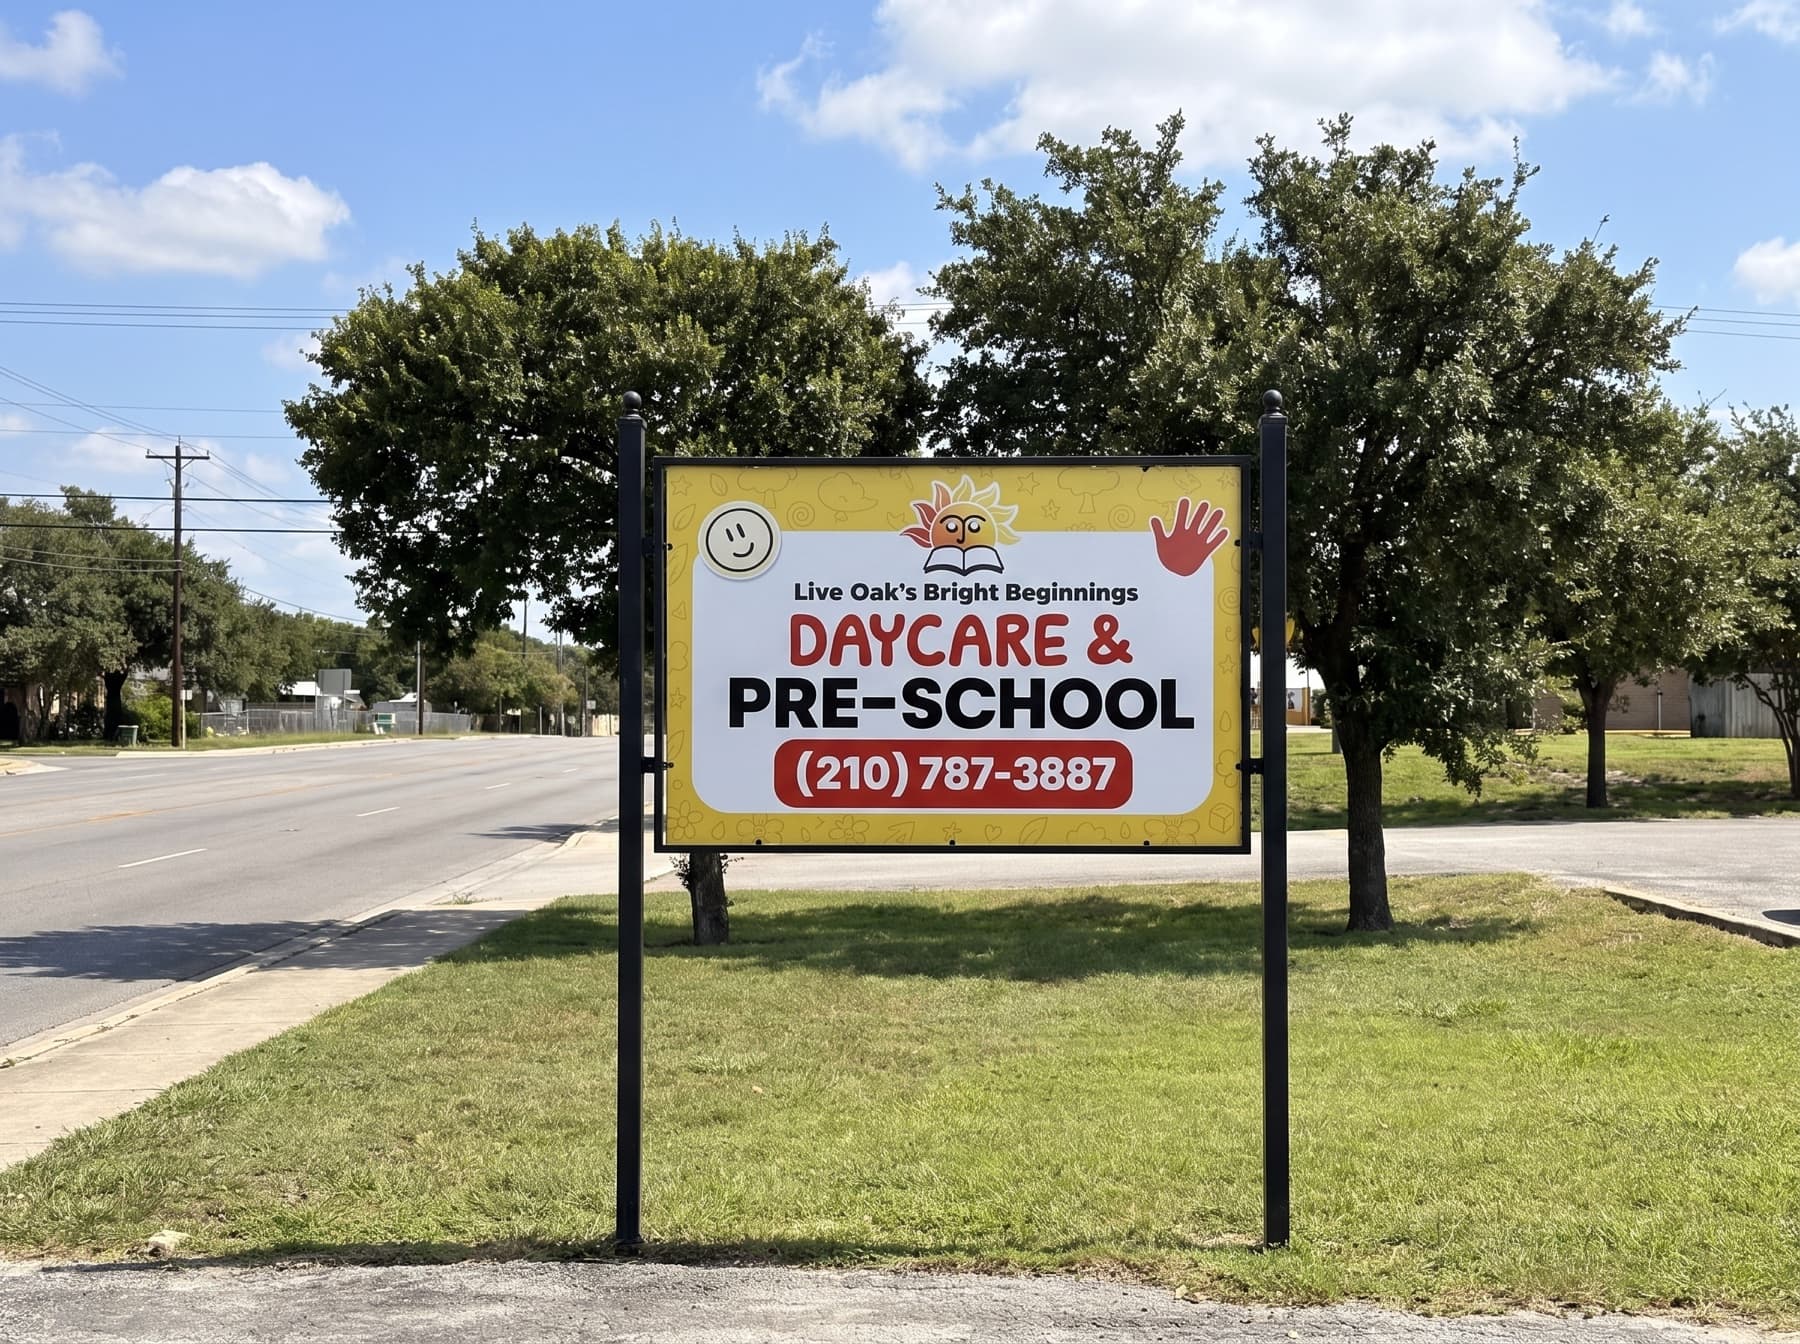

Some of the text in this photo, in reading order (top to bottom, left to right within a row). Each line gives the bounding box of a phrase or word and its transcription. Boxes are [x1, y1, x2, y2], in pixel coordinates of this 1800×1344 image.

[795, 581, 1139, 605] Live Oak's Bright Beginnings
[790, 613, 1134, 667] DAYCARE &
[728, 677, 1195, 731] PRE-SCHOOL
[796, 750, 1117, 798] (210) 787-3887
